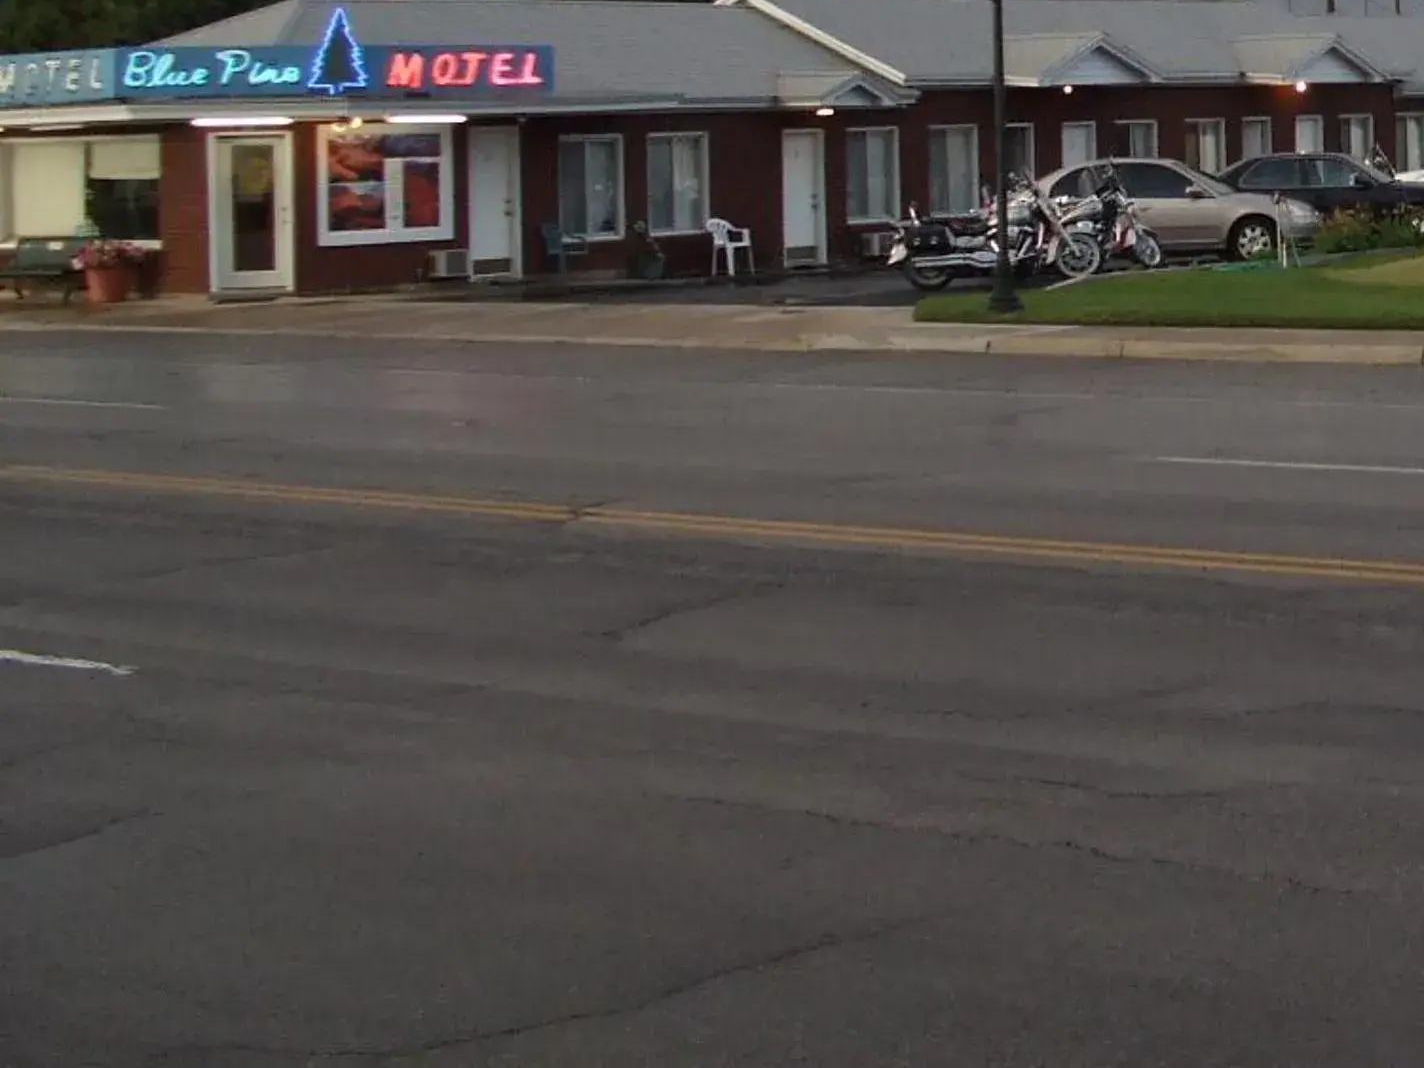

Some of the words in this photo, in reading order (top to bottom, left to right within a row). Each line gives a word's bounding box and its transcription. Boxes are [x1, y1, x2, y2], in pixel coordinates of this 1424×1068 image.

[123, 51, 208, 87] Blue
[214, 49, 301, 85] Pine
[386, 52, 544, 88] MOTEL
